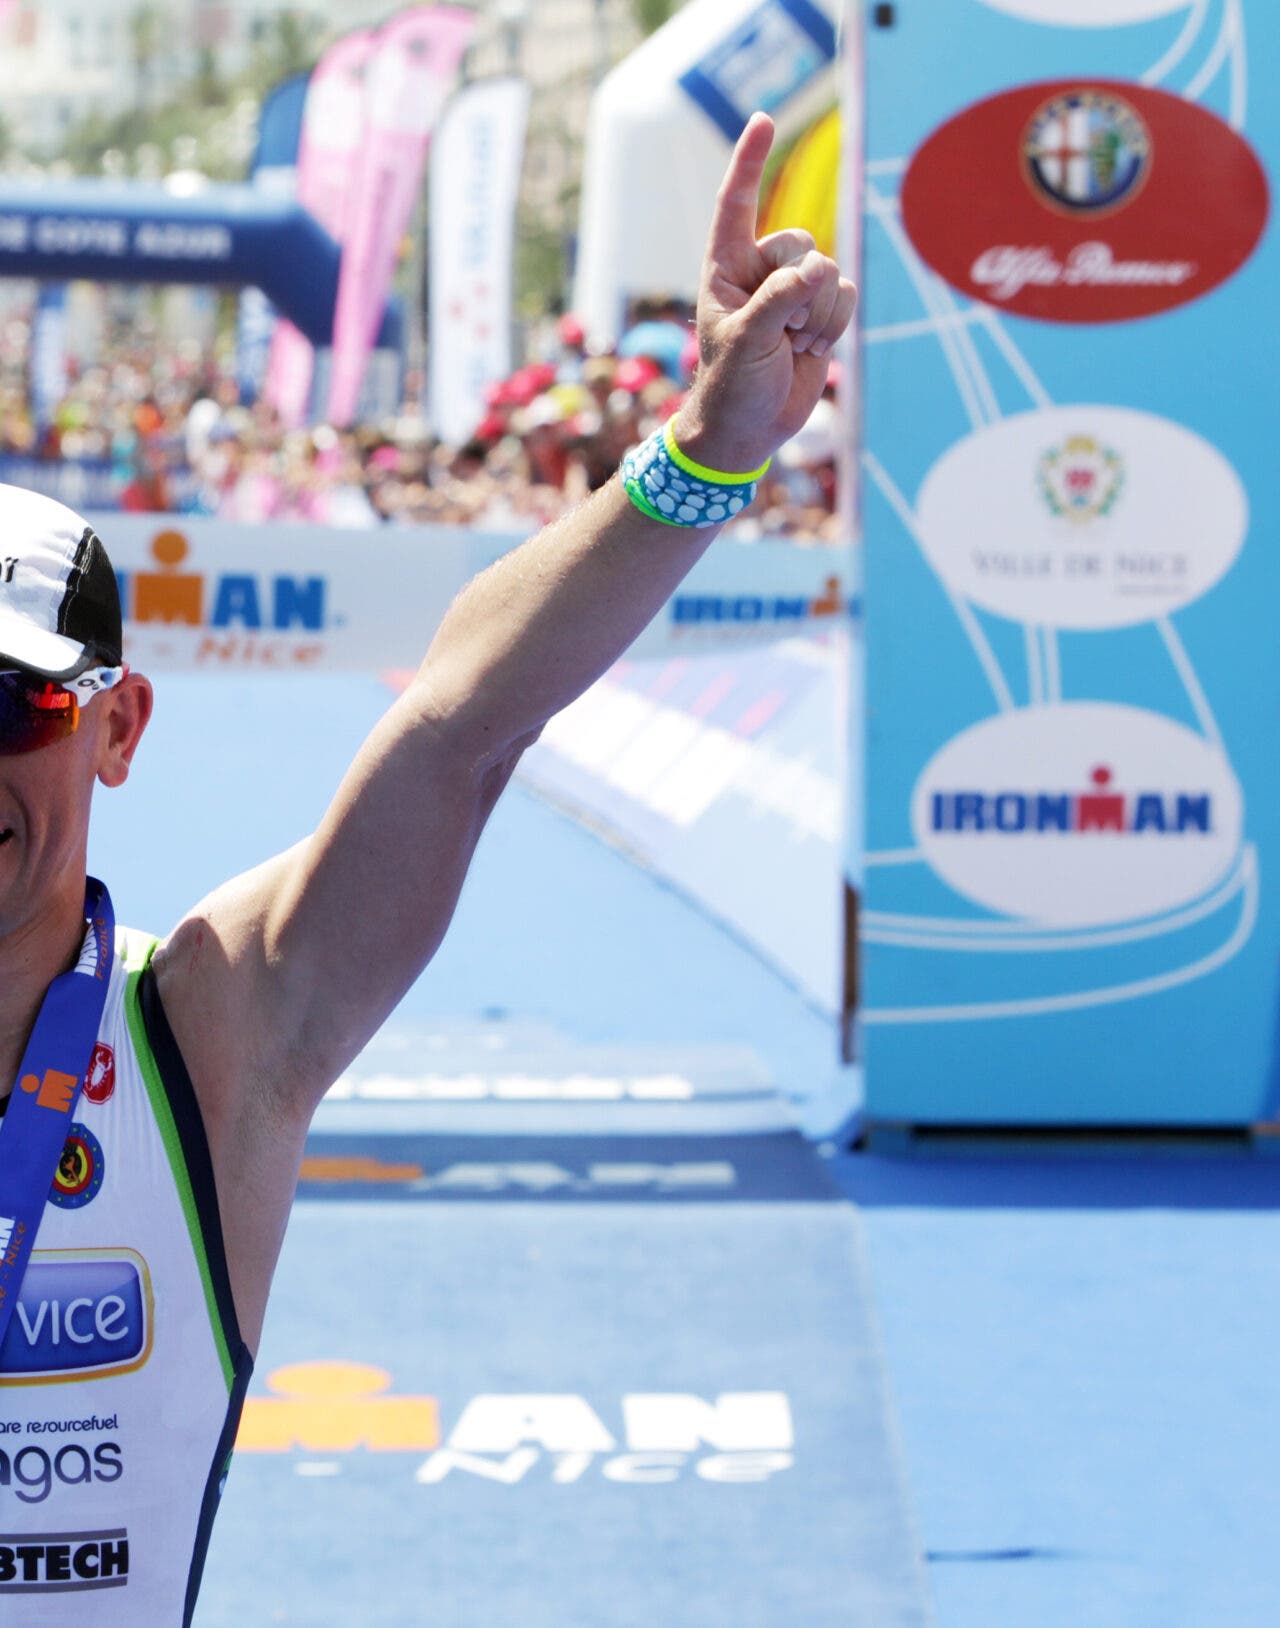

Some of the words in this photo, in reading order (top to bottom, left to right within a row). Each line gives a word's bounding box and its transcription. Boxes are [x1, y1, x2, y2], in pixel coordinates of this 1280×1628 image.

[930, 764, 1210, 833] IRONMAN
[4, 1221, 26, 1266] Nice
[26, 1413, 119, 1434] resourcefuel
